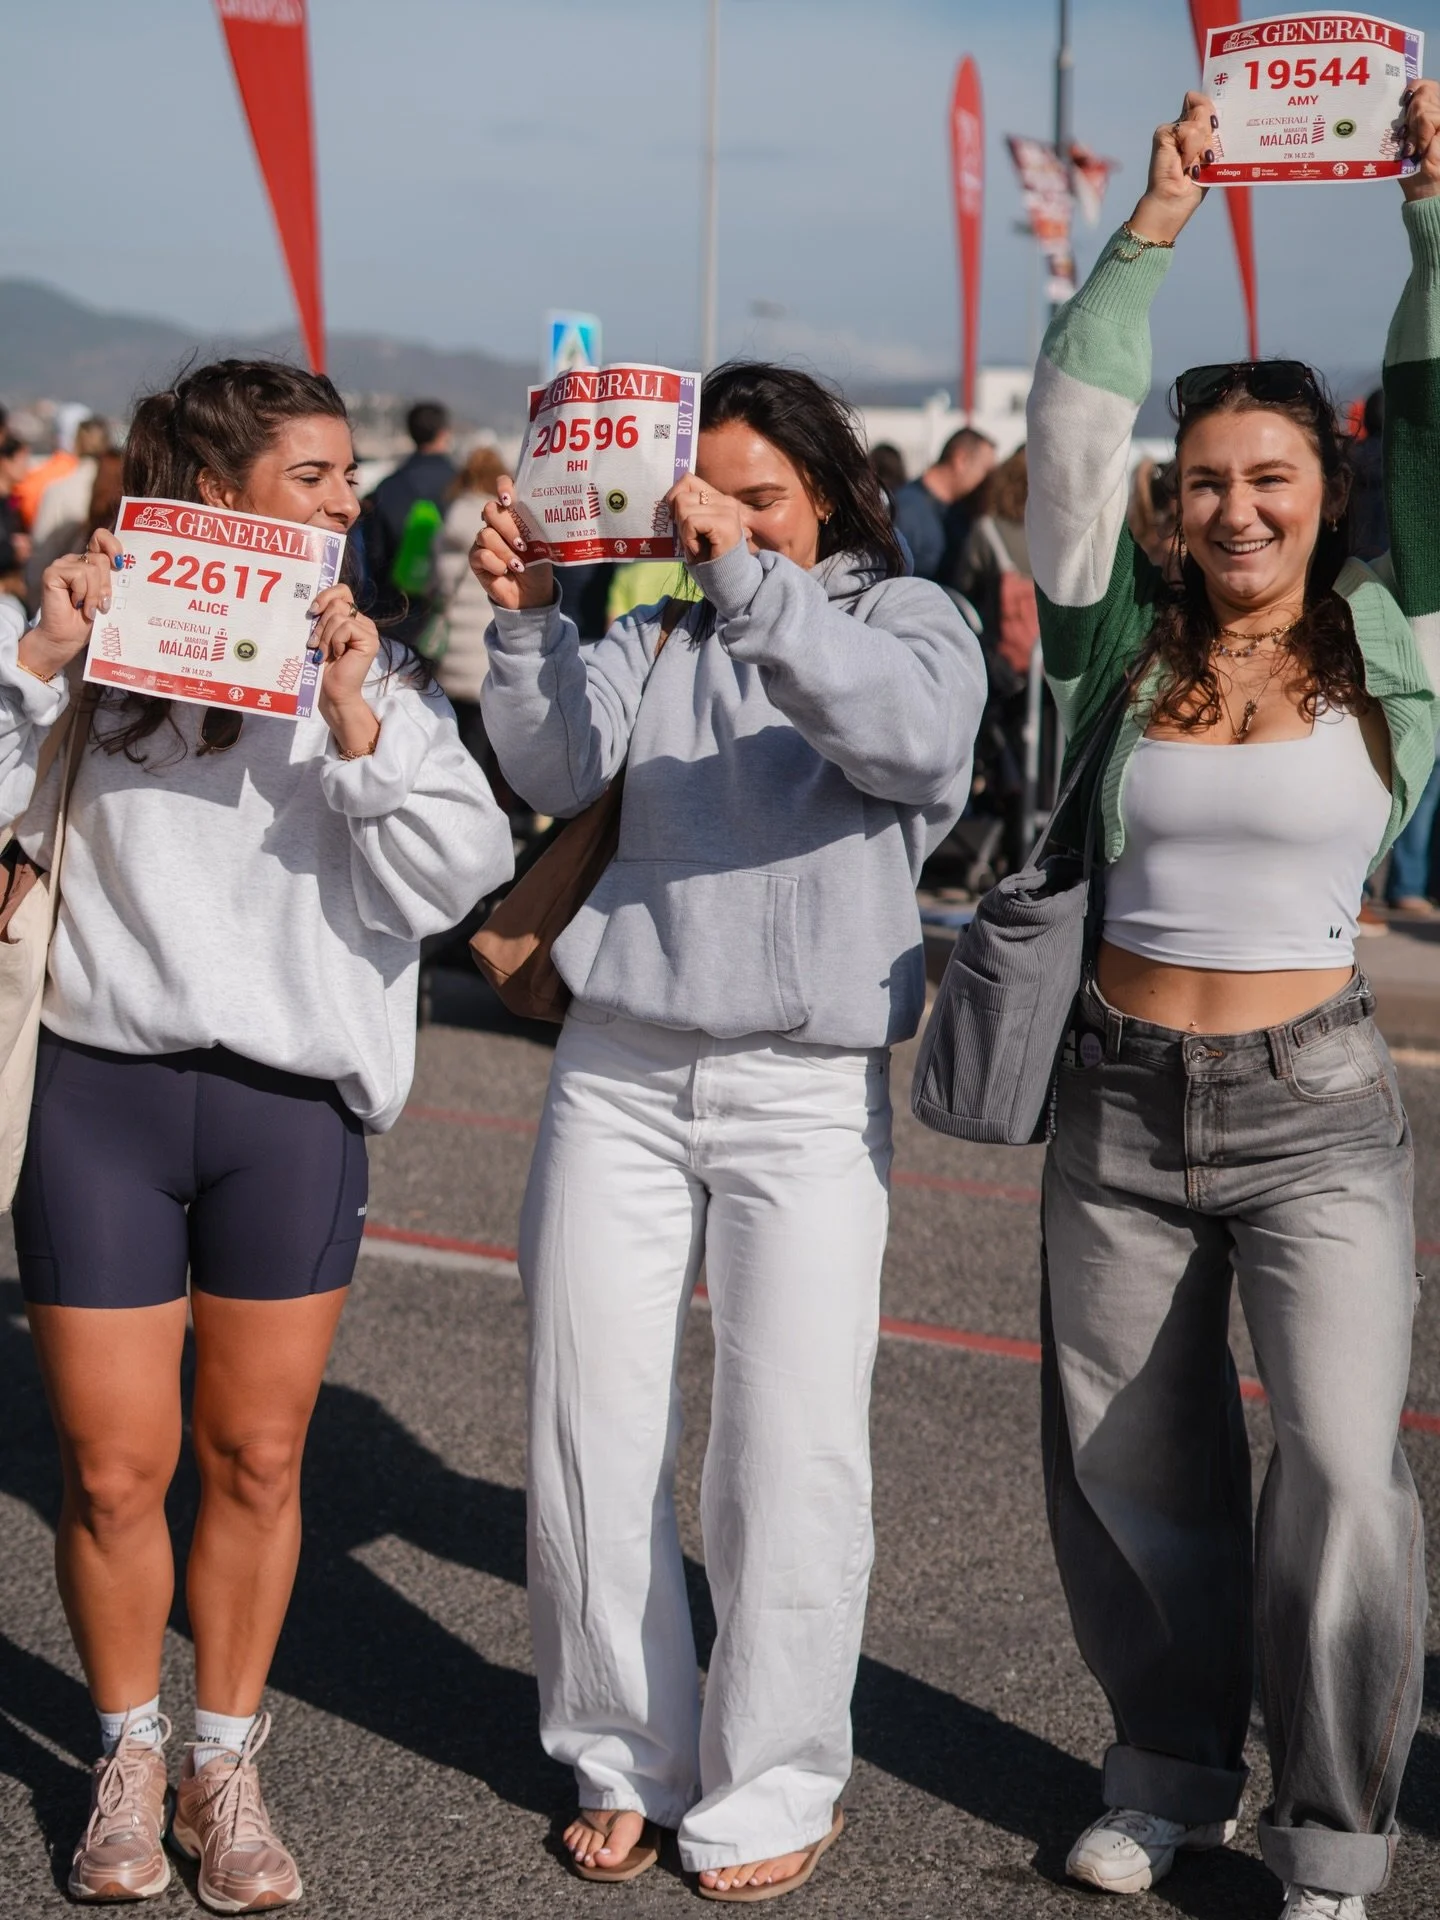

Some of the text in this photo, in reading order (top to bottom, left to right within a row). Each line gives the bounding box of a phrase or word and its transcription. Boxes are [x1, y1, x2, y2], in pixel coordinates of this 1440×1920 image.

[1262, 19, 1392, 47] GENERALI
[1405, 32, 1419, 43] 21K
[1244, 56, 1371, 90] 19544
[1405, 53, 1418, 80] BOX 7
[1287, 95, 1319, 106] AMY
[1261, 115, 1309, 126] GENERALI
[1260, 132, 1308, 146] MÁLAGA
[551, 373, 665, 406] GENERALI
[680, 377, 694, 387] 21K
[678, 400, 693, 436] BOX 7
[532, 415, 639, 458] 20596
[567, 460, 588, 472] RHI
[675, 458, 689, 467] 21K
[543, 484, 583, 497] GENERALI
[544, 505, 587, 524] MÁLAGA
[175, 511, 309, 557] GENERALI
[326, 537, 340, 549] 21K
[322, 562, 335, 571] 7
[146, 550, 282, 603] 22617
[187, 599, 230, 617] ALICE
[163, 618, 212, 636] GENERALI
[159, 639, 208, 661] MÁLAGA
[296, 705, 310, 716] 21K
